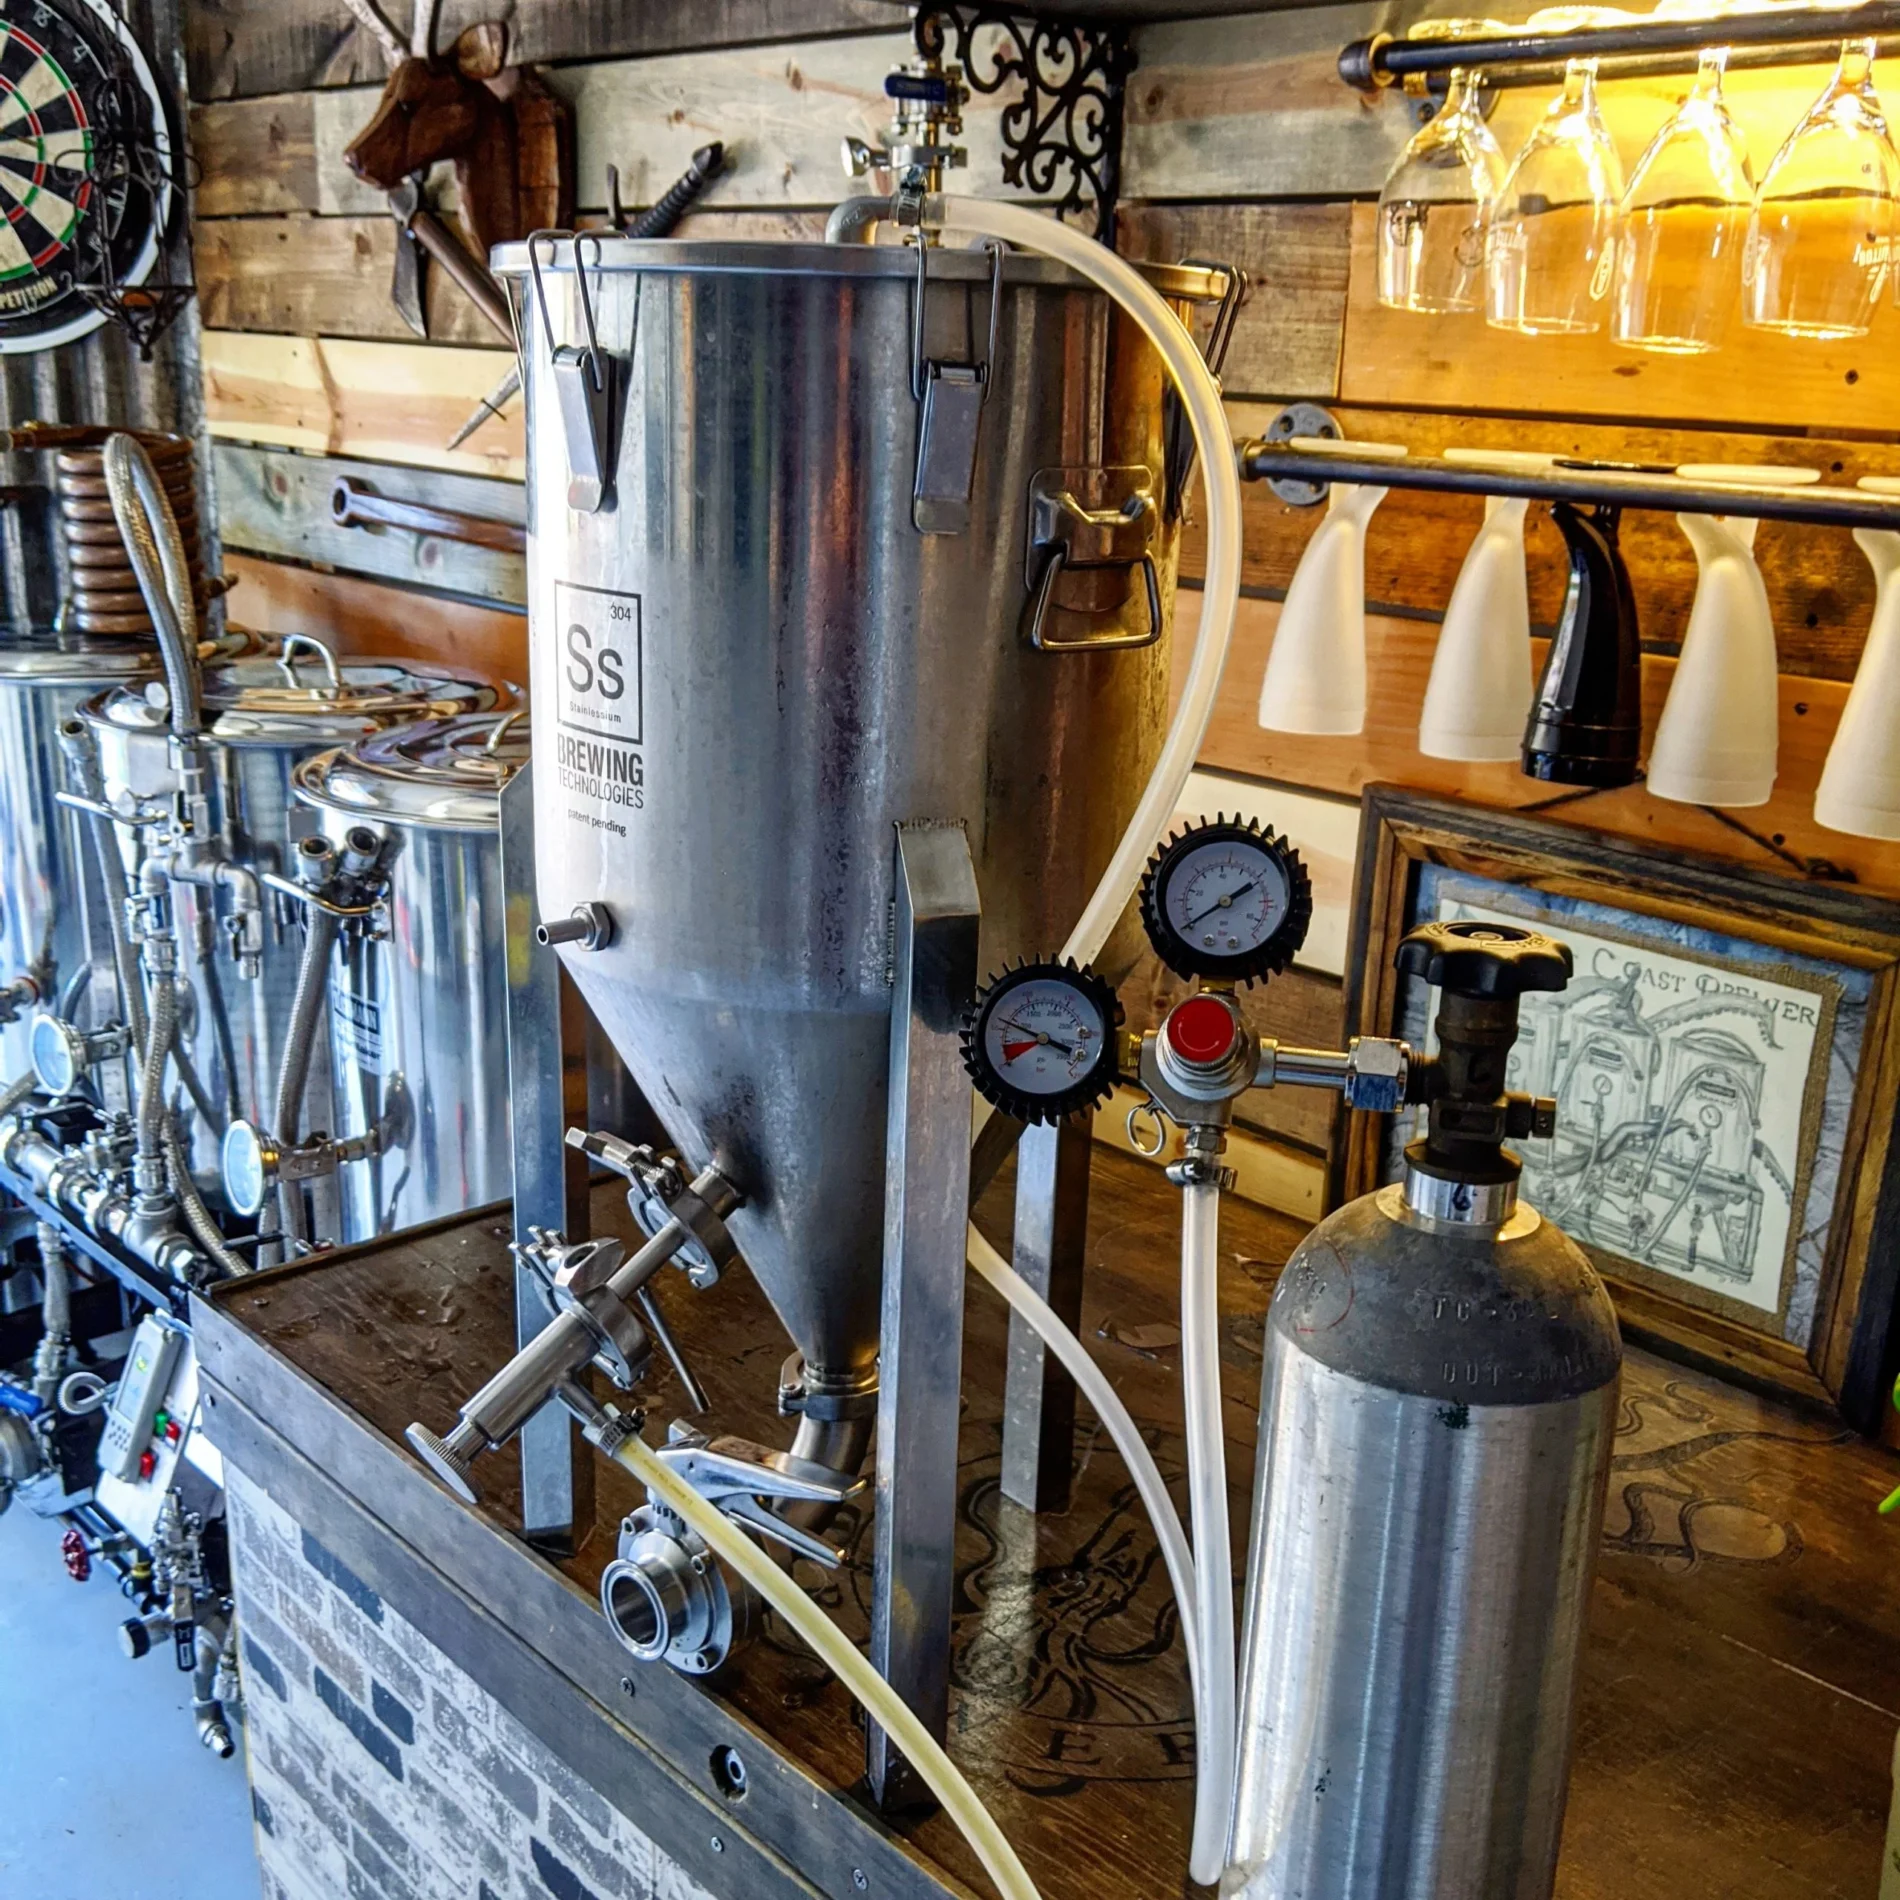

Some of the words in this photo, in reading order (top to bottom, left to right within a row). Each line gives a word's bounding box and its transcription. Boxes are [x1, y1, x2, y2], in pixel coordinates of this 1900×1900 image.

[610, 604, 632, 622] 304
[566, 623, 625, 700] Ss
[569, 700, 622, 724] Stainlessium
[557, 732, 644, 788] BREWING
[558, 765, 644, 810] TECHNOLOGIES
[568, 808, 590, 825] patent
[591, 816, 627, 838] pending
